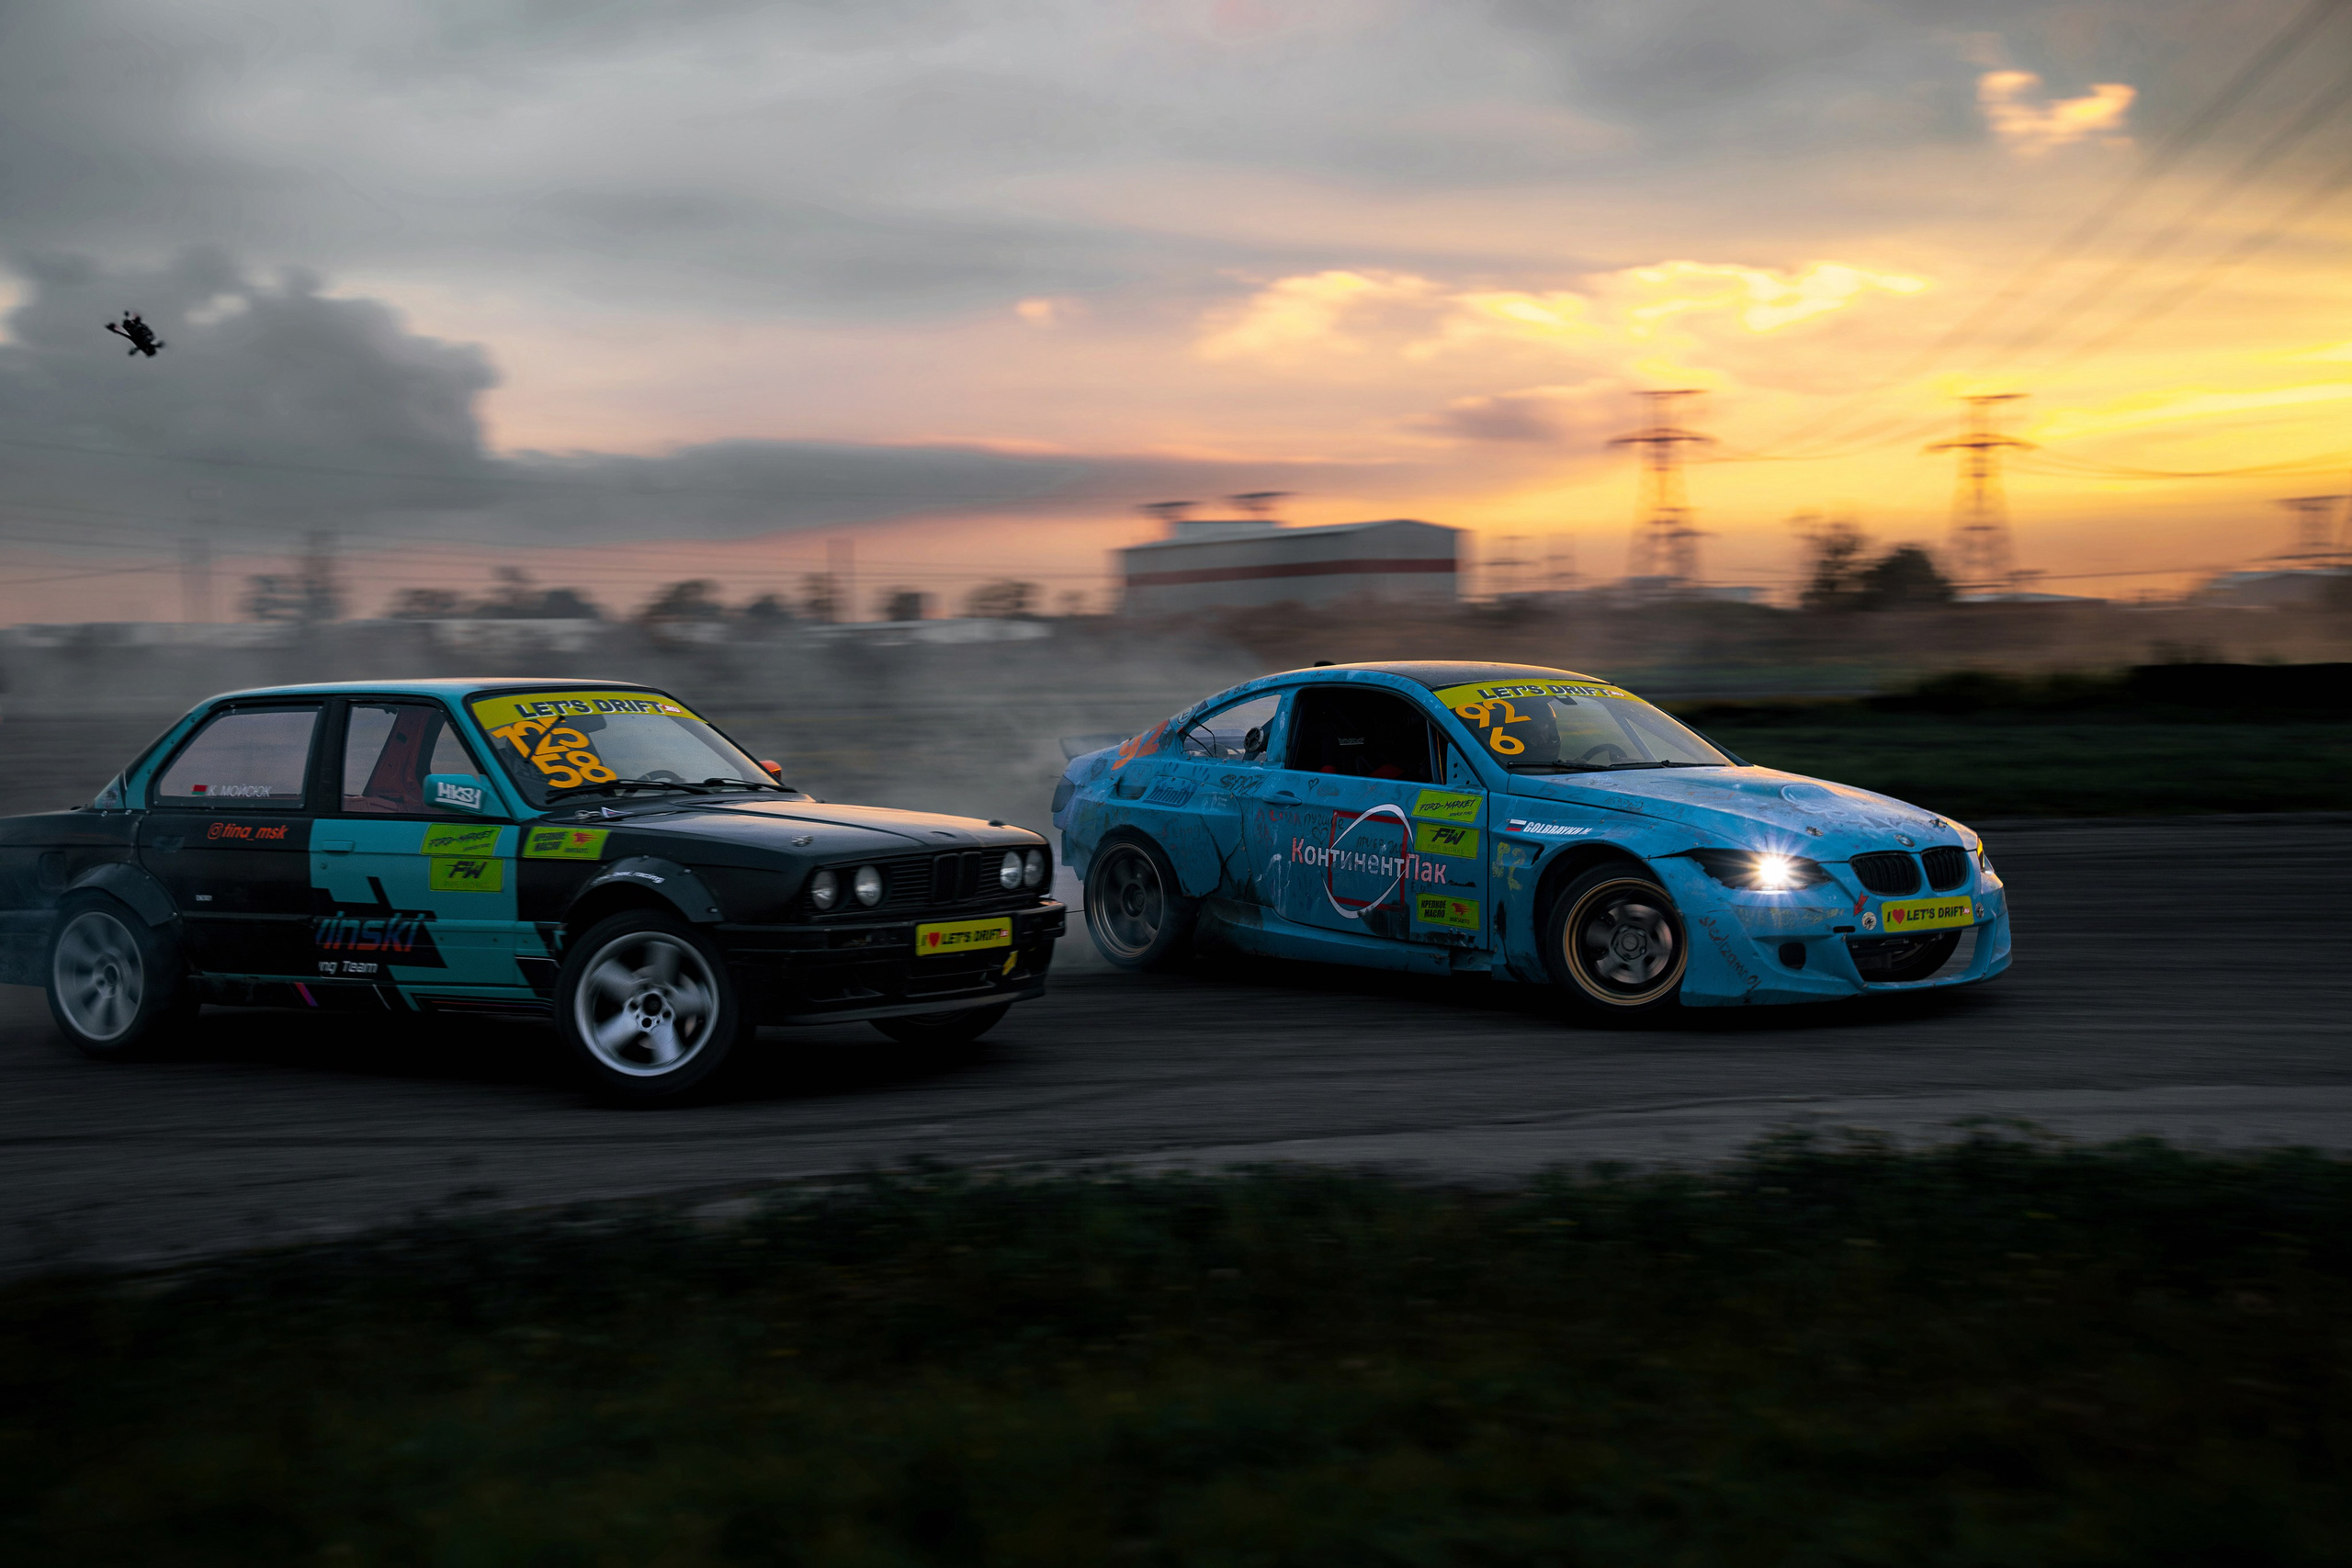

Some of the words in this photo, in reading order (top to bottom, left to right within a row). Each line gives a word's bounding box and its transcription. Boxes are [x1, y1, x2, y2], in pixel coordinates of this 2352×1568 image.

[1476, 684, 1546, 700] LET'S
[514, 699, 593, 718] LET'S
[1455, 699, 1532, 728] 92
[1489, 727, 1525, 755] 6
[530, 750, 617, 788] 58
[1419, 799, 1476, 812] FORD-MARKET
[1291, 837, 1447, 885] КонтинентПак
[1421, 900, 1446, 908] КРЕПКОЕ
[1424, 909, 1445, 919] МАСЛО
[1887, 911, 1891, 922] I
[1907, 908, 1935, 921] LET'S
[942, 931, 972, 945] LET'S
[342, 960, 379, 974] Team
